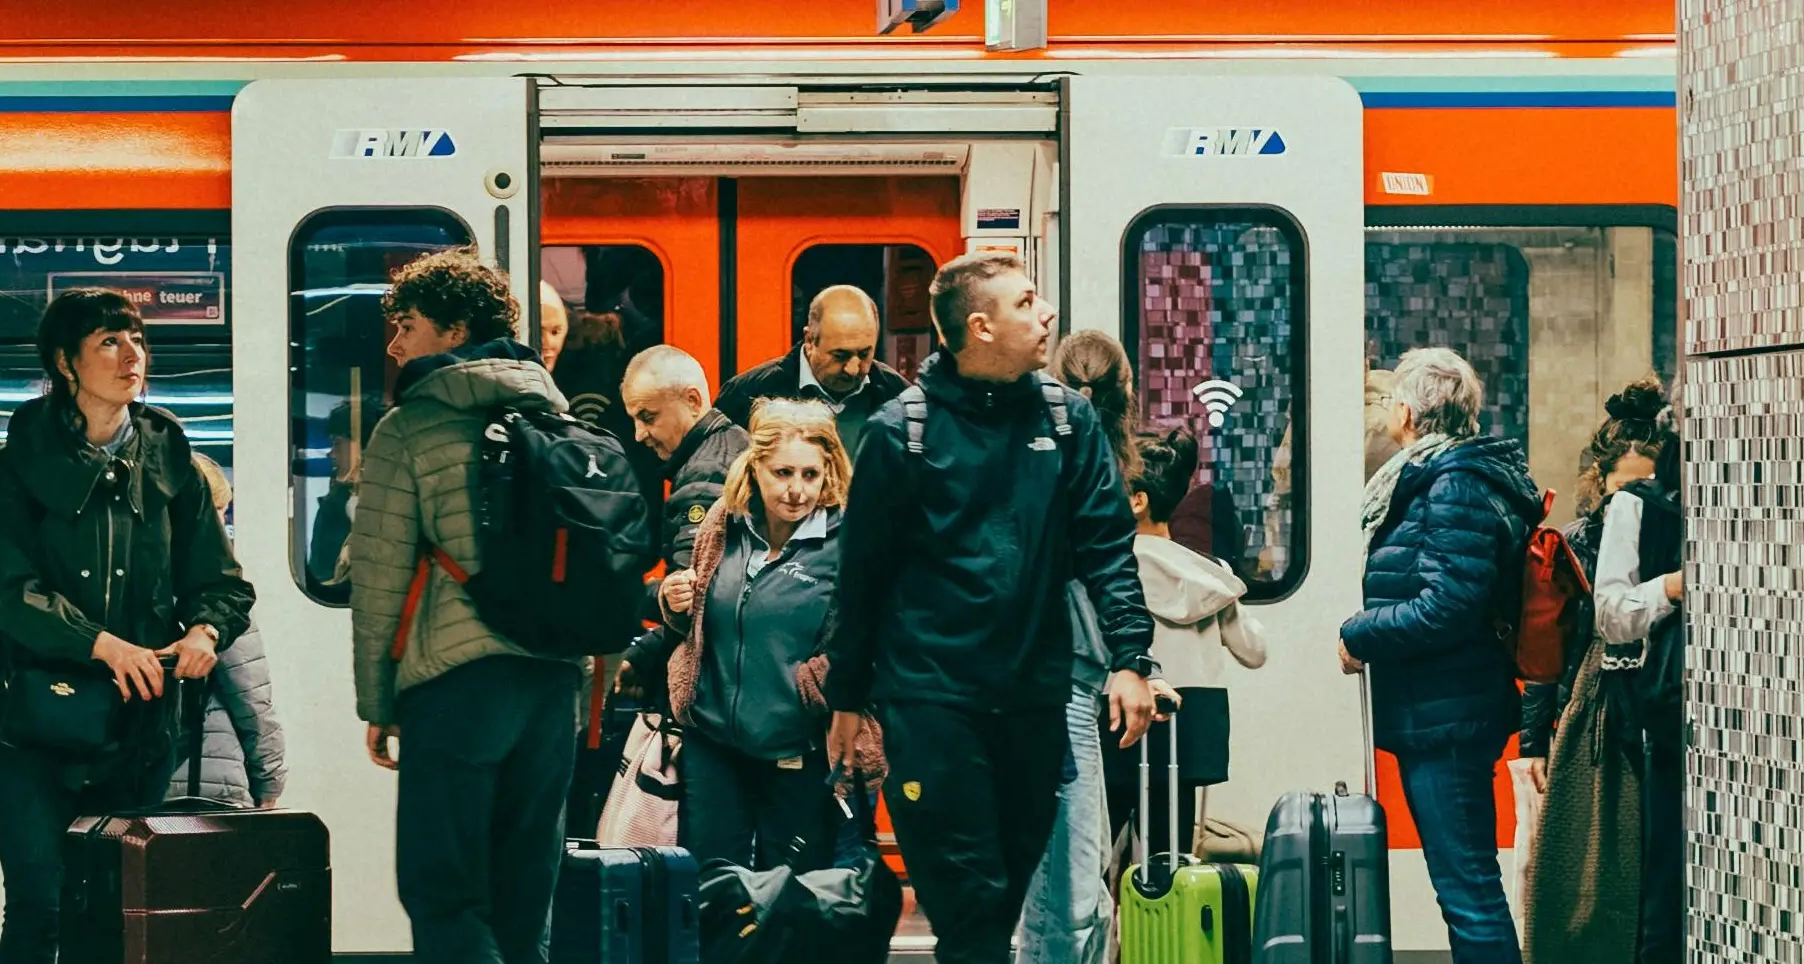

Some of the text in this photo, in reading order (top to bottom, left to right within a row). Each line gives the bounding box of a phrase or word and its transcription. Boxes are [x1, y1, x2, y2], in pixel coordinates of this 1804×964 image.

[354, 129, 440, 157] RMV
[1184, 128, 1270, 156] RMV
[122, 289, 203, 304] hne teuer
